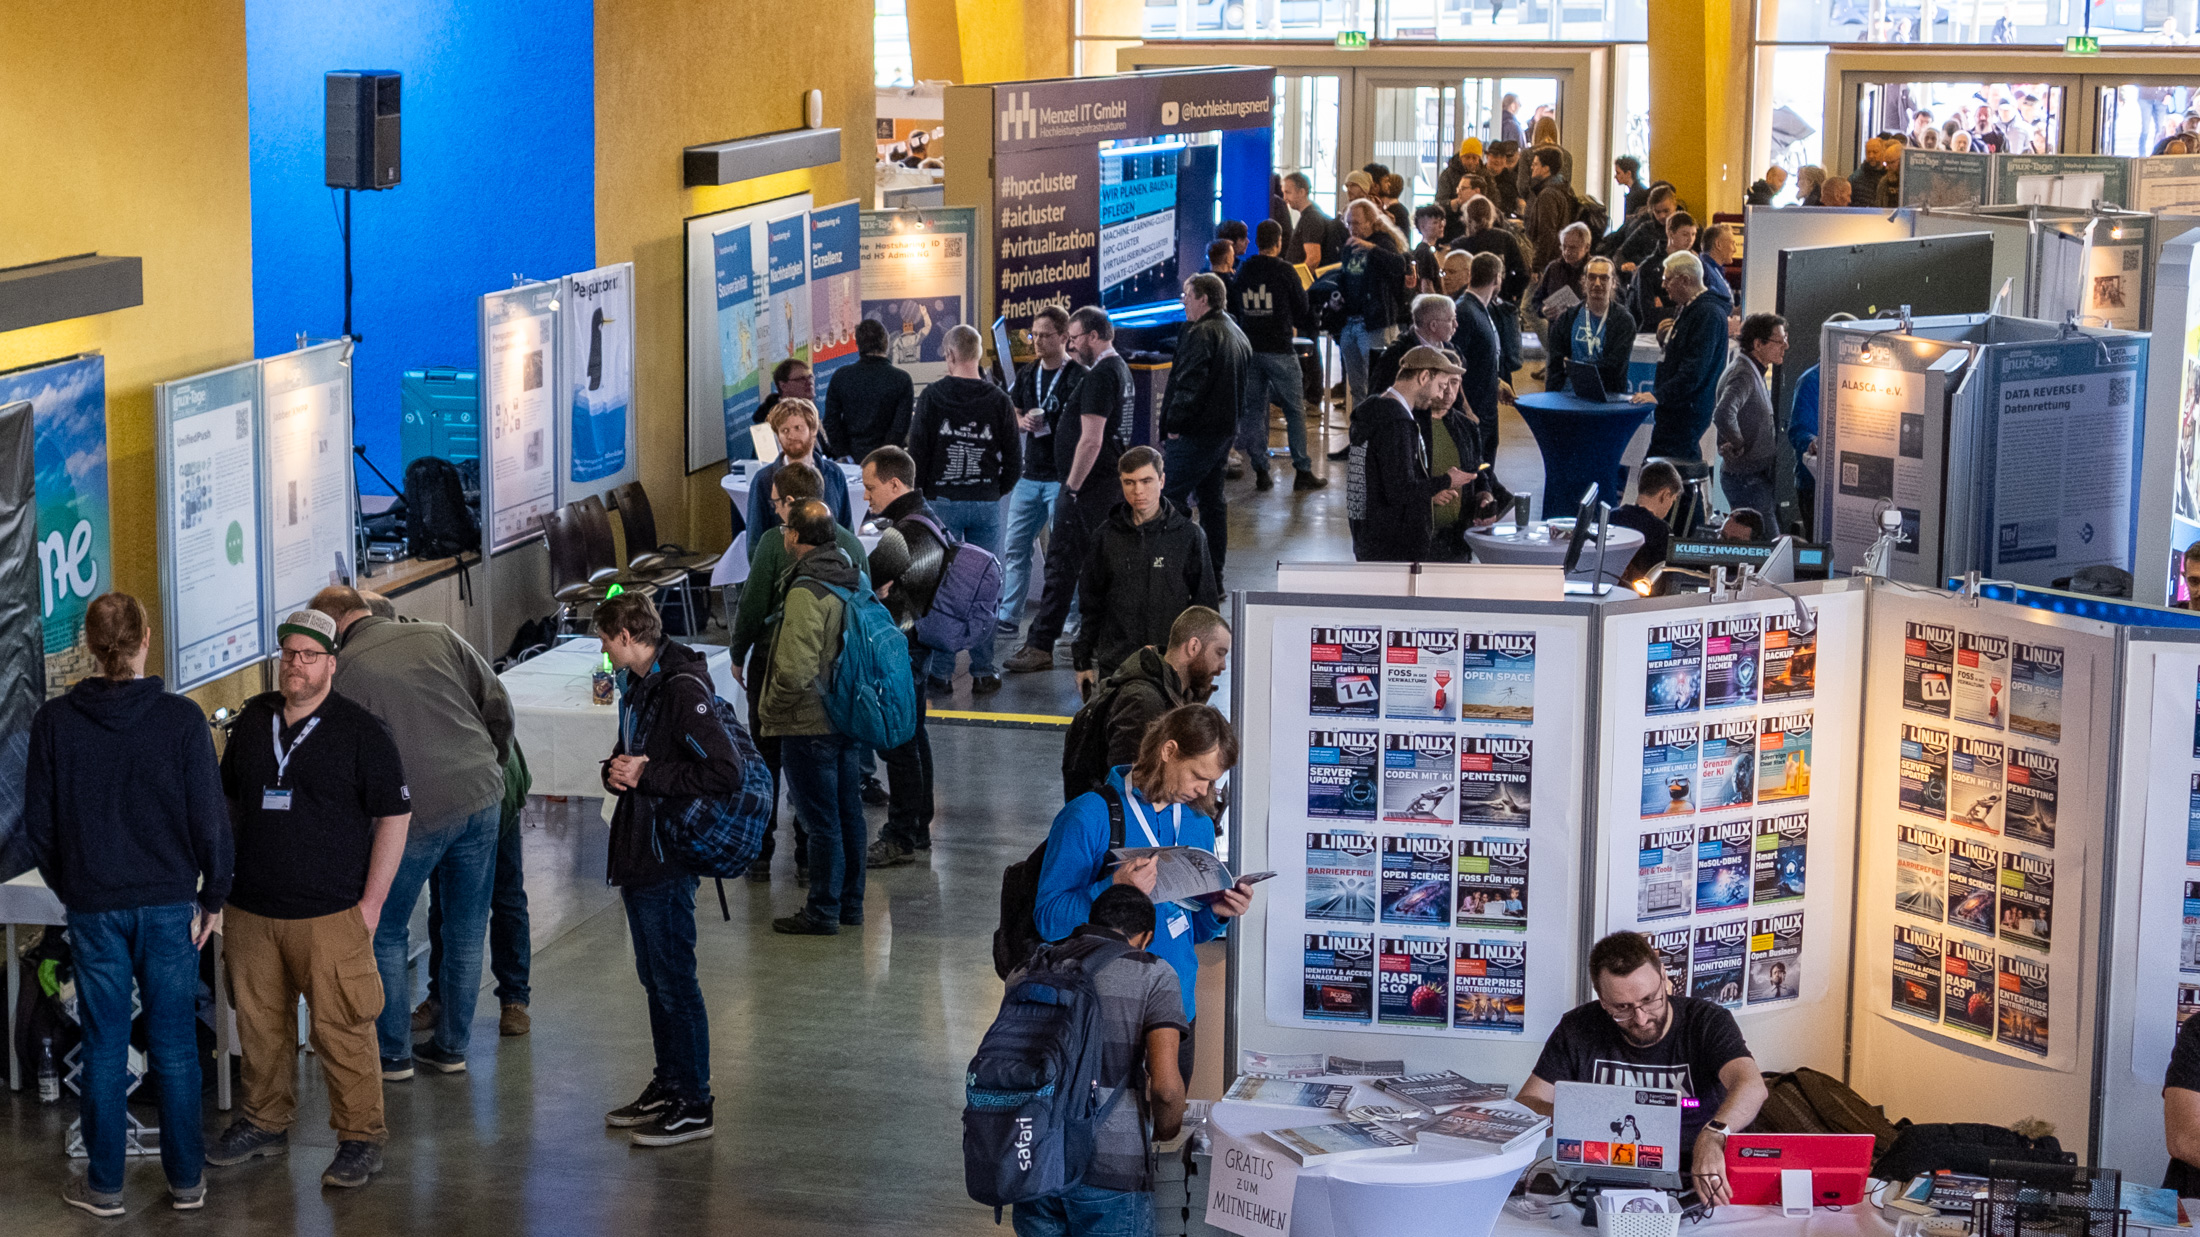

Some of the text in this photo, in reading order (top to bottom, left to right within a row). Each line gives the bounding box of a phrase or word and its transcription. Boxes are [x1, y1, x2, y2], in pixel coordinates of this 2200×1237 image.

[1040, 101, 1126, 125] Menzel IT GmbH
[1182, 97, 1269, 121] @hochleistungsnerd
[1040, 121, 1126, 137] Hochleistungsinfrastrukturen
[1001, 172, 1077, 199] #hpccluster
[1103, 187, 1118, 202] WIR
[1150, 180, 1168, 192] BAUEN
[1001, 204, 1065, 228] #aicluster
[1103, 202, 1135, 219] PFLEGEN
[1103, 213, 1173, 241] MACHINE-LEARNING-CLUSTER
[1001, 229, 1095, 258] #virtualization
[1103, 236, 1139, 257] HPC-CLUSTER
[813, 251, 843, 268] Exzellenz
[1001, 256, 1090, 293] #privatecloud
[1104, 251, 1164, 285] PRIVATE-CLOUD-CLUSTER
[1001, 291, 1071, 319] #networks
[1842, 380, 1902, 396] ALASCA e.V.
[2005, 384, 2085, 400] DATA REVERSE®
[2004, 401, 2070, 414] Datenrettung
[177, 430, 211, 447] UnifiedPush
[1675, 544, 1772, 556] KUBEINVADERS
[1659, 625, 1701, 642] LINUX
[1718, 619, 1759, 636] LINUX
[1916, 625, 1953, 644] LINUX
[1325, 629, 1380, 644] LINUX
[1401, 632, 1457, 648] LINUX
[1478, 635, 1533, 650] LINUX
[1968, 635, 2007, 655] LINUX
[1707, 654, 1738, 663] NUMMER
[1765, 650, 1794, 660] BACKUP
[2023, 646, 2062, 666] LINUX
[1335, 665, 1355, 673] statt
[1648, 657, 1701, 669] WER DARF WAS?
[1707, 662, 1732, 670] SICHER
[1906, 658, 1920, 666] Linux
[1921, 662, 1935, 670] statt
[1388, 669, 1412, 677] FOSS
[1464, 672, 1532, 682] OPEN SPACE
[1958, 671, 1974, 680] FOSS
[1340, 683, 1373, 700] 14
[1924, 681, 1947, 697] 14
[2012, 681, 2060, 698] OPEN SPACE
[1714, 721, 1755, 738] LINUX
[1772, 714, 1812, 731] LINUX
[1323, 732, 1377, 748] LINUX
[1399, 735, 1454, 751] LINUX
[1655, 727, 1698, 745] LINUX
[1475, 739, 1531, 754] LINUX
[1703, 759, 1732, 768] Grenzen
[1760, 752, 1787, 762] Sovereign
[1310, 767, 1357, 777] SERVER-
[1703, 768, 1724, 777] der KI
[1901, 760, 1934, 774] SERVER-
[1310, 776, 1350, 785] UPDATES
[1385, 771, 1452, 781] CODEN MIT KI
[1461, 773, 1527, 783] PENTESTING
[1901, 769, 1929, 782] UPDATES
[1953, 773, 1976, 785] CODEN
[1977, 779, 1990, 787] MIT
[2008, 783, 2054, 801] PENTESTING
[1709, 823, 1751, 840] LINUX
[1767, 815, 1807, 833] LINUX
[1321, 834, 1374, 849] LINUX
[1397, 837, 1451, 853] LINUX
[1651, 830, 1693, 848] LINUX
[1473, 842, 1527, 857] LINUX
[1756, 851, 1778, 861] Smart
[1699, 856, 1742, 868] NoSQL-DBMS
[1756, 862, 1774, 870] Home
[1308, 868, 1374, 877] BARRIEREFREI!
[1383, 871, 1450, 881] OPEN SCIENCE
[1459, 873, 1525, 885] FOSS FÜR KIDS
[1639, 868, 1649, 876] Git
[1950, 873, 1995, 892] OPEN SCIENCE
[2002, 886, 2050, 905] FOSS FÜR KIDS
[1762, 915, 1802, 933] LINUX
[1705, 923, 1747, 942] LINUX
[1318, 936, 1372, 950] LINUX
[1394, 940, 1448, 955] LINUX
[1470, 944, 1524, 959] LINUX
[1751, 947, 1797, 960] Open Business
[1305, 967, 1337, 975] IDENTITY
[1694, 958, 1742, 972] MONITORING
[1894, 965, 1927, 979] MANAGEMENT
[1923, 966, 1940, 977] ACCESS
[1305, 974, 1353, 982] MANAGEMENT
[1380, 973, 1423, 984] RASPI
[1456, 977, 1523, 988] ENTERPRISE
[1946, 974, 1976, 992] RASPI
[1380, 984, 1407, 993] & CO
[1456, 986, 1523, 995] DISTRIBUTIONEN
[1953, 988, 1965, 998] CO
[2000, 989, 2047, 1010] ENTERPRISE
[2000, 998, 2047, 1018] DISTRIBUTIONEN
[1397, 1072, 1454, 1083] LINUX
[1476, 1107, 1546, 1122] LINUX
[1015, 1118, 1032, 1171] safari
[1225, 1149, 1274, 1180] GRATIS
[1237, 1178, 1258, 1195] ZUM
[1212, 1190, 1287, 1230] MITNEHMEN
